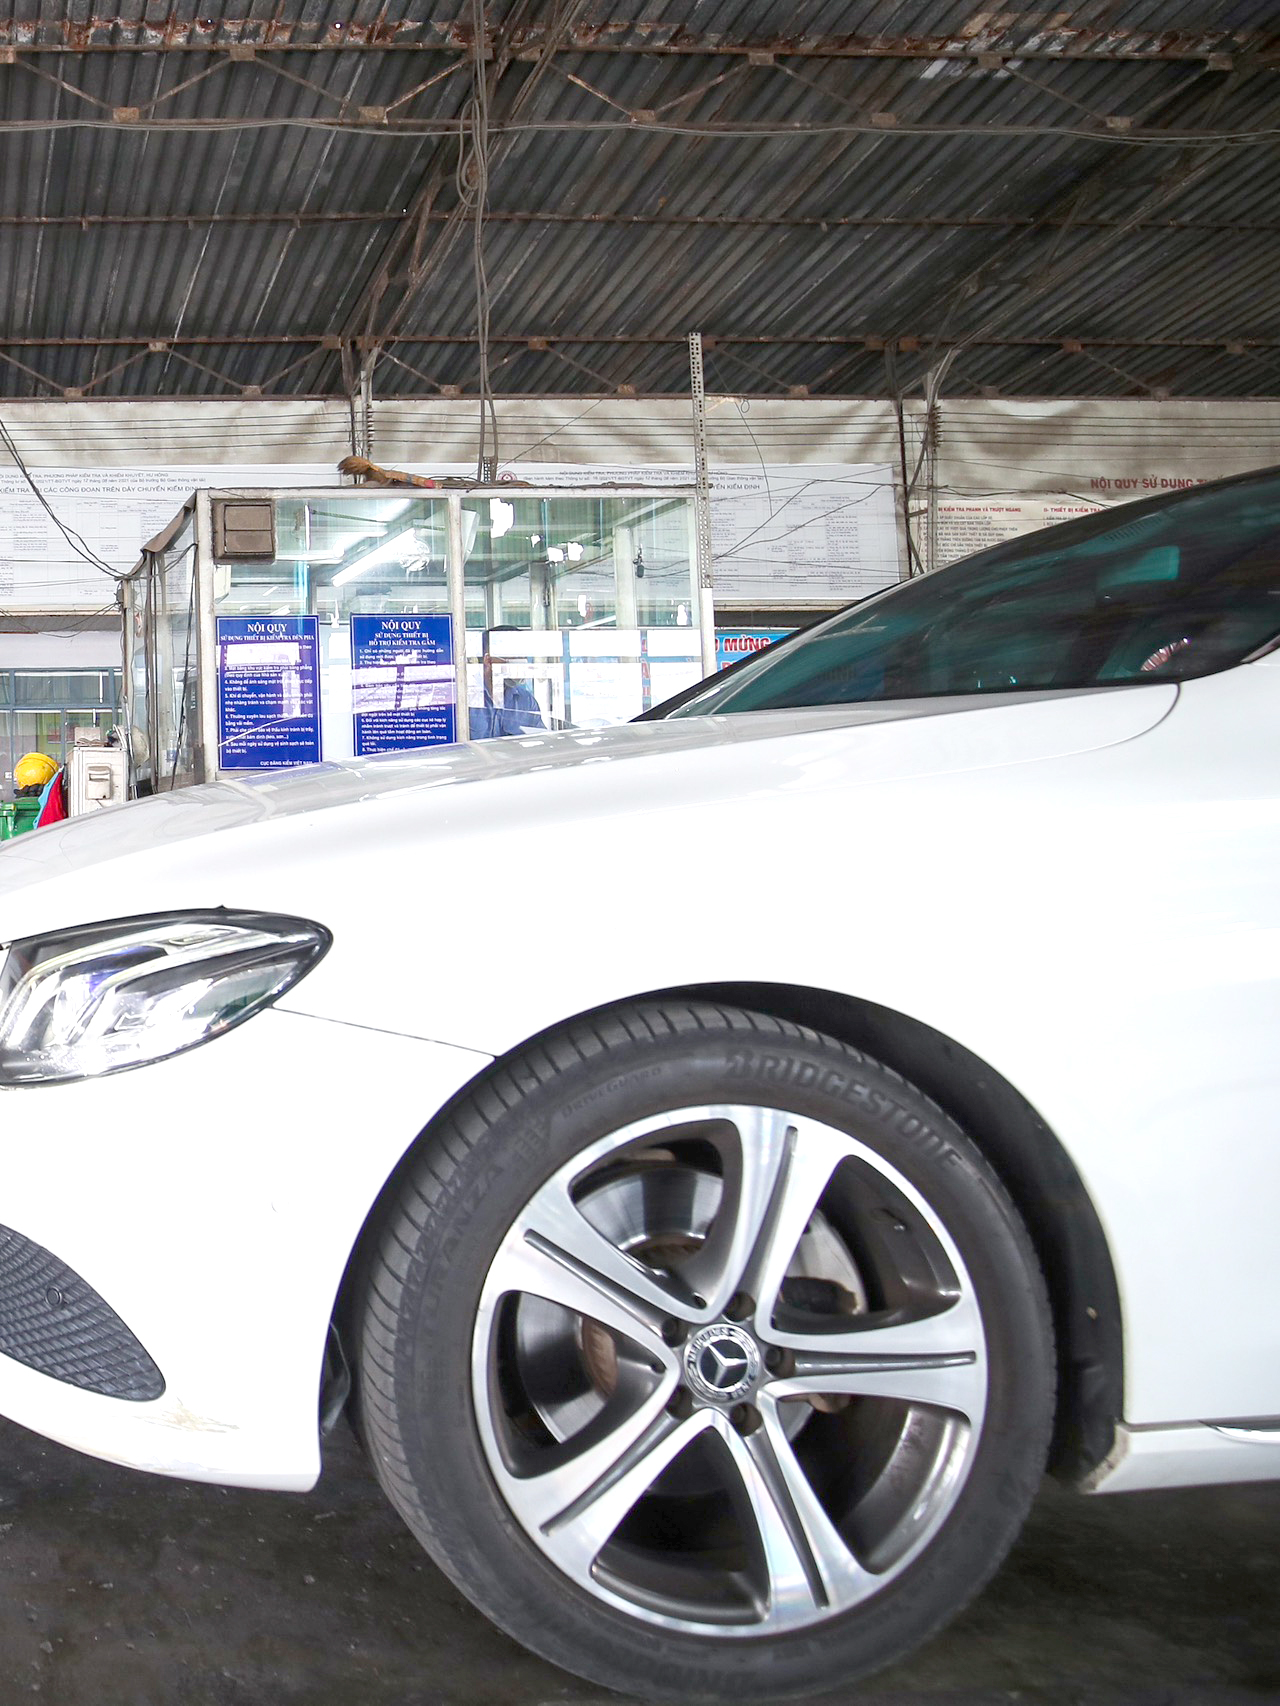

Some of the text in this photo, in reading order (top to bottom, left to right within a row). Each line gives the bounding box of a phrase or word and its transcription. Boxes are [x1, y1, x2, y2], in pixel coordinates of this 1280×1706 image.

[1090, 476, 1111, 492] NỘI
[1115, 479, 1139, 489] QUY
[1142, 474, 1159, 489] SỬ
[247, 621, 287, 634] NỘI QUY
[381, 619, 421, 632] NỘI QUY
[369, 638, 378, 646] HỖ
[392, 638, 408, 646] KIỂM
[723, 1049, 964, 1170] BRIDGESTONE
